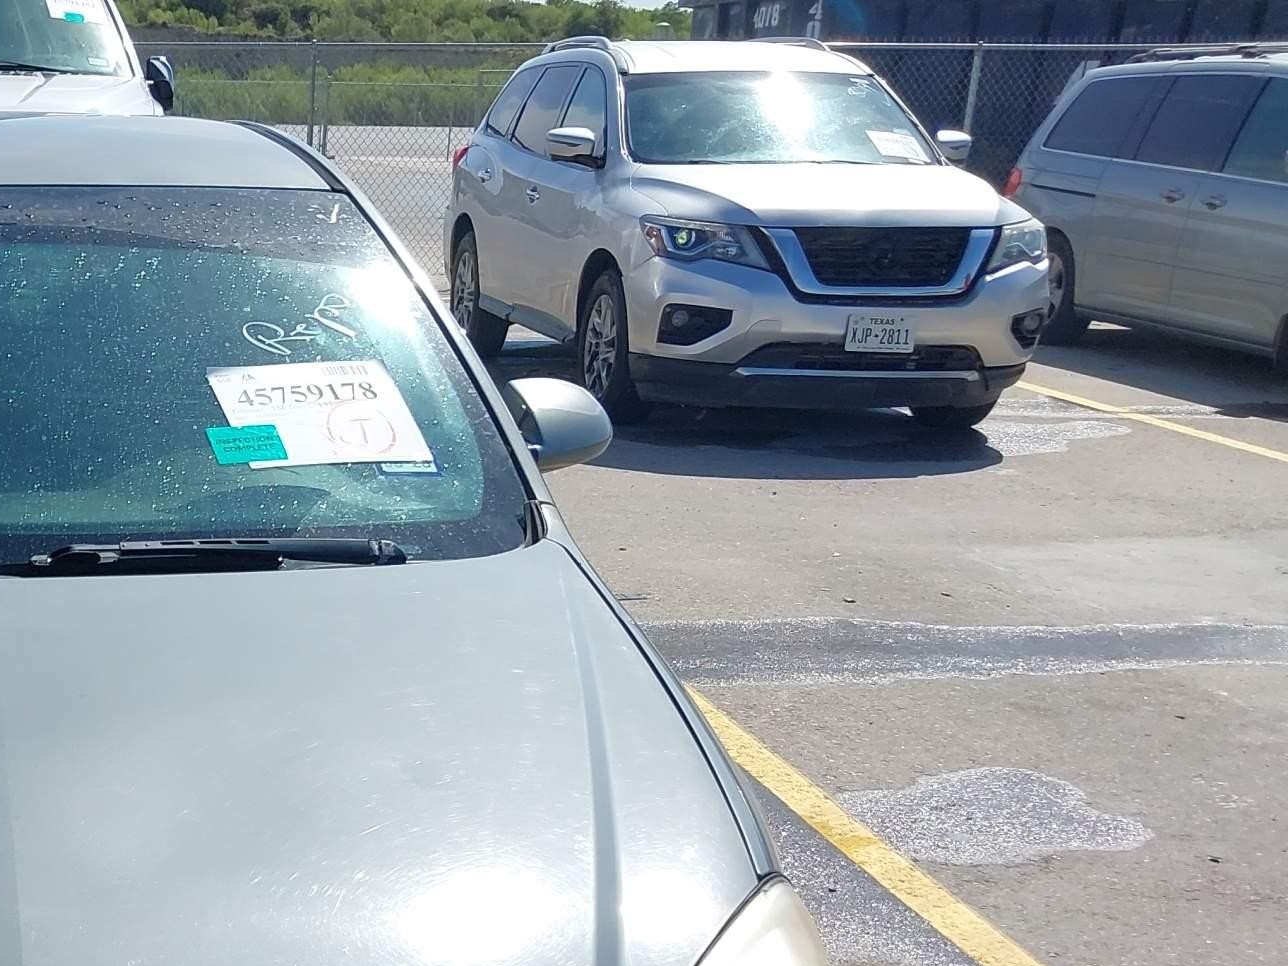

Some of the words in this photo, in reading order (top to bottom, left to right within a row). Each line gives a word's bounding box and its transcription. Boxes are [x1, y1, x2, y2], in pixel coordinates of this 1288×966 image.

[869, 318, 895, 326] TEXAS
[237, 381, 378, 407] 45759178
[215, 434, 275, 446] INSPECTION
[223, 443, 276, 453] COMPLETE
